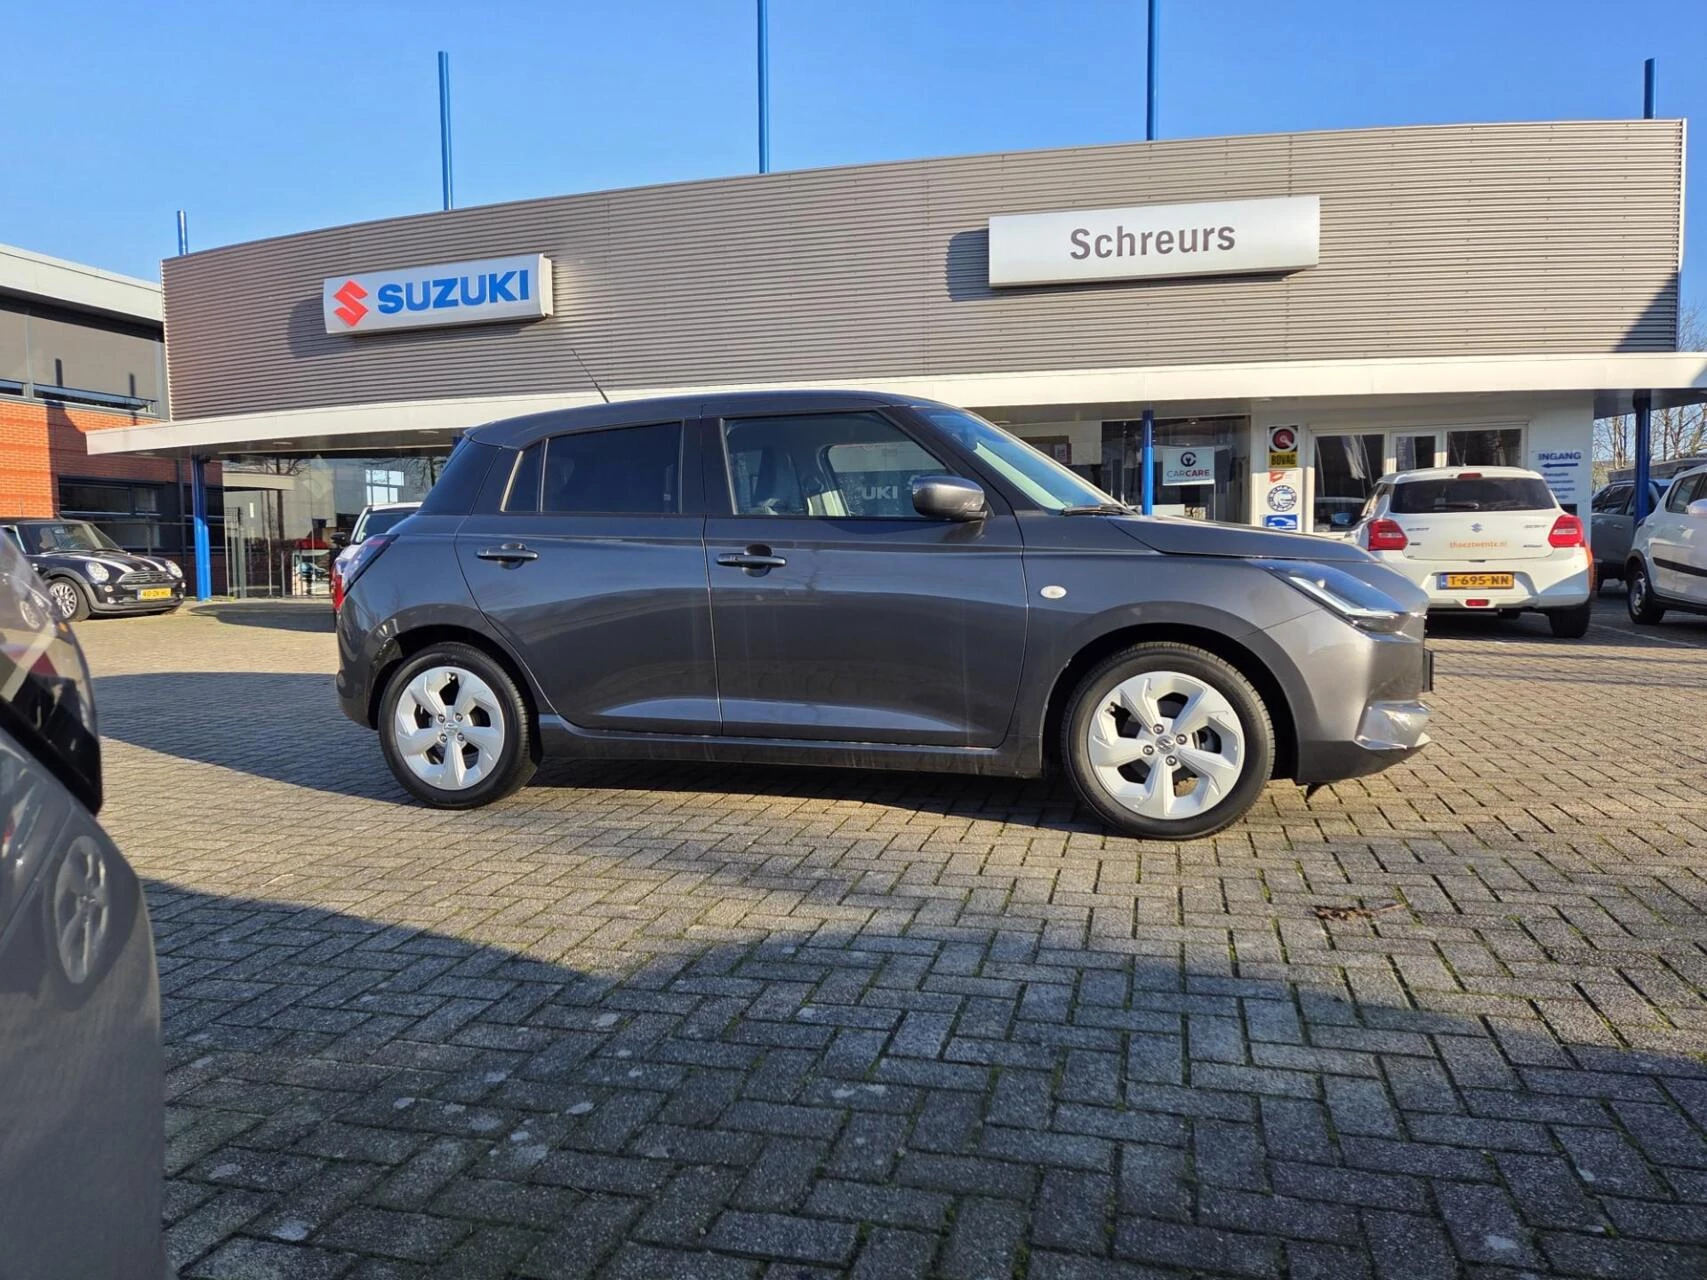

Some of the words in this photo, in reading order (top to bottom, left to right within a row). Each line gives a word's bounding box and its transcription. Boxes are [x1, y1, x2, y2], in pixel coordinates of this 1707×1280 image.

[1070, 226, 1236, 260] Schreurs
[377, 269, 530, 315] SUZUKI
[1271, 453, 1296, 466] BOVAG
[1538, 451, 1582, 461] INGANG
[1451, 574, 1509, 586] T-695-NN
